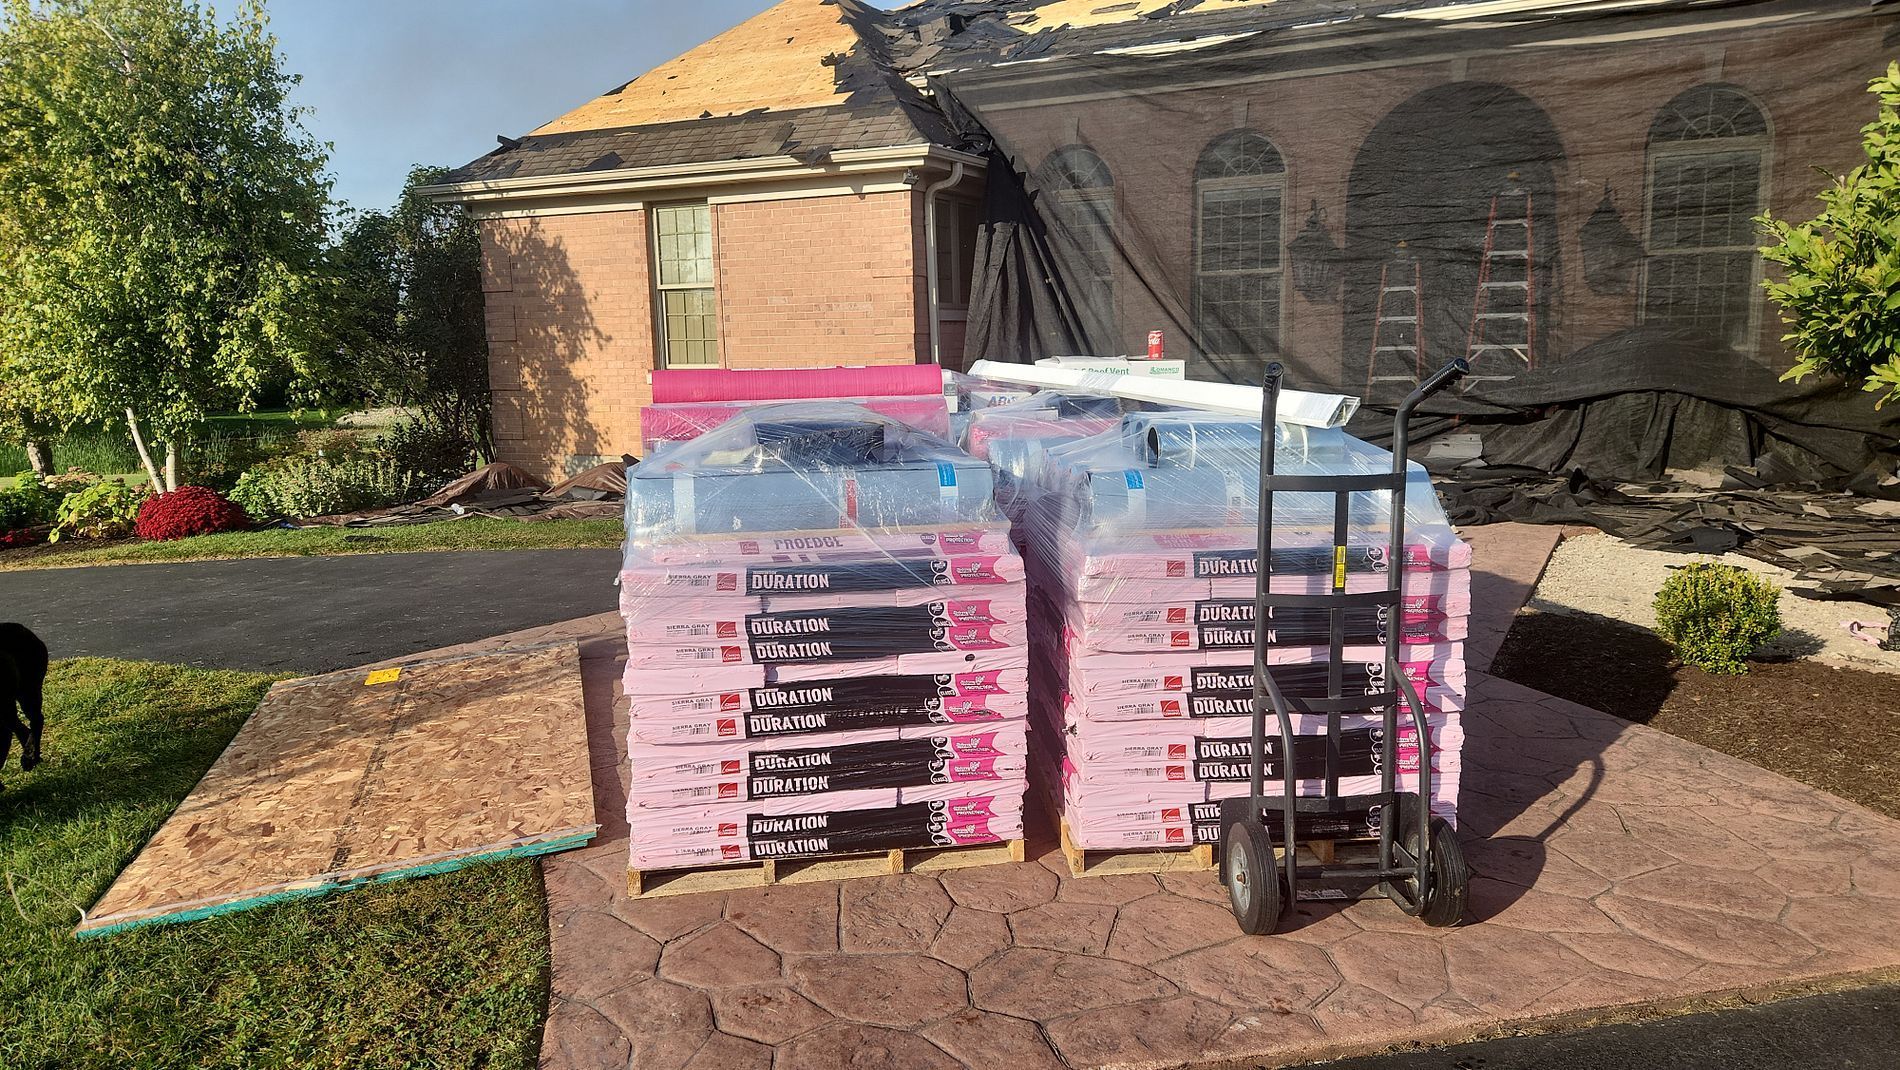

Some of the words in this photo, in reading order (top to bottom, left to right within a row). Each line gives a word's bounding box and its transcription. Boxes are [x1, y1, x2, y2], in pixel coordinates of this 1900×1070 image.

[775, 536, 844, 550] PROEDGE
[752, 573, 829, 589] DURATION
[1200, 606, 1274, 621] DURATI
[752, 618, 830, 635] DURATION
[1204, 629, 1277, 645] DURATIN
[755, 642, 833, 659] DURATION
[1197, 675, 1254, 690] DURATI
[755, 688, 833, 707] DURATION
[1193, 698, 1253, 715] DURATI
[751, 714, 827, 733] DURATION
[1200, 742, 1273, 759] DURATIN
[755, 752, 832, 770] DURATION
[1199, 763, 1273, 778] DURATIN
[753, 776, 829, 795] DURATION
[752, 816, 828, 834] DURATION
[755, 838, 829, 856] DURATION
